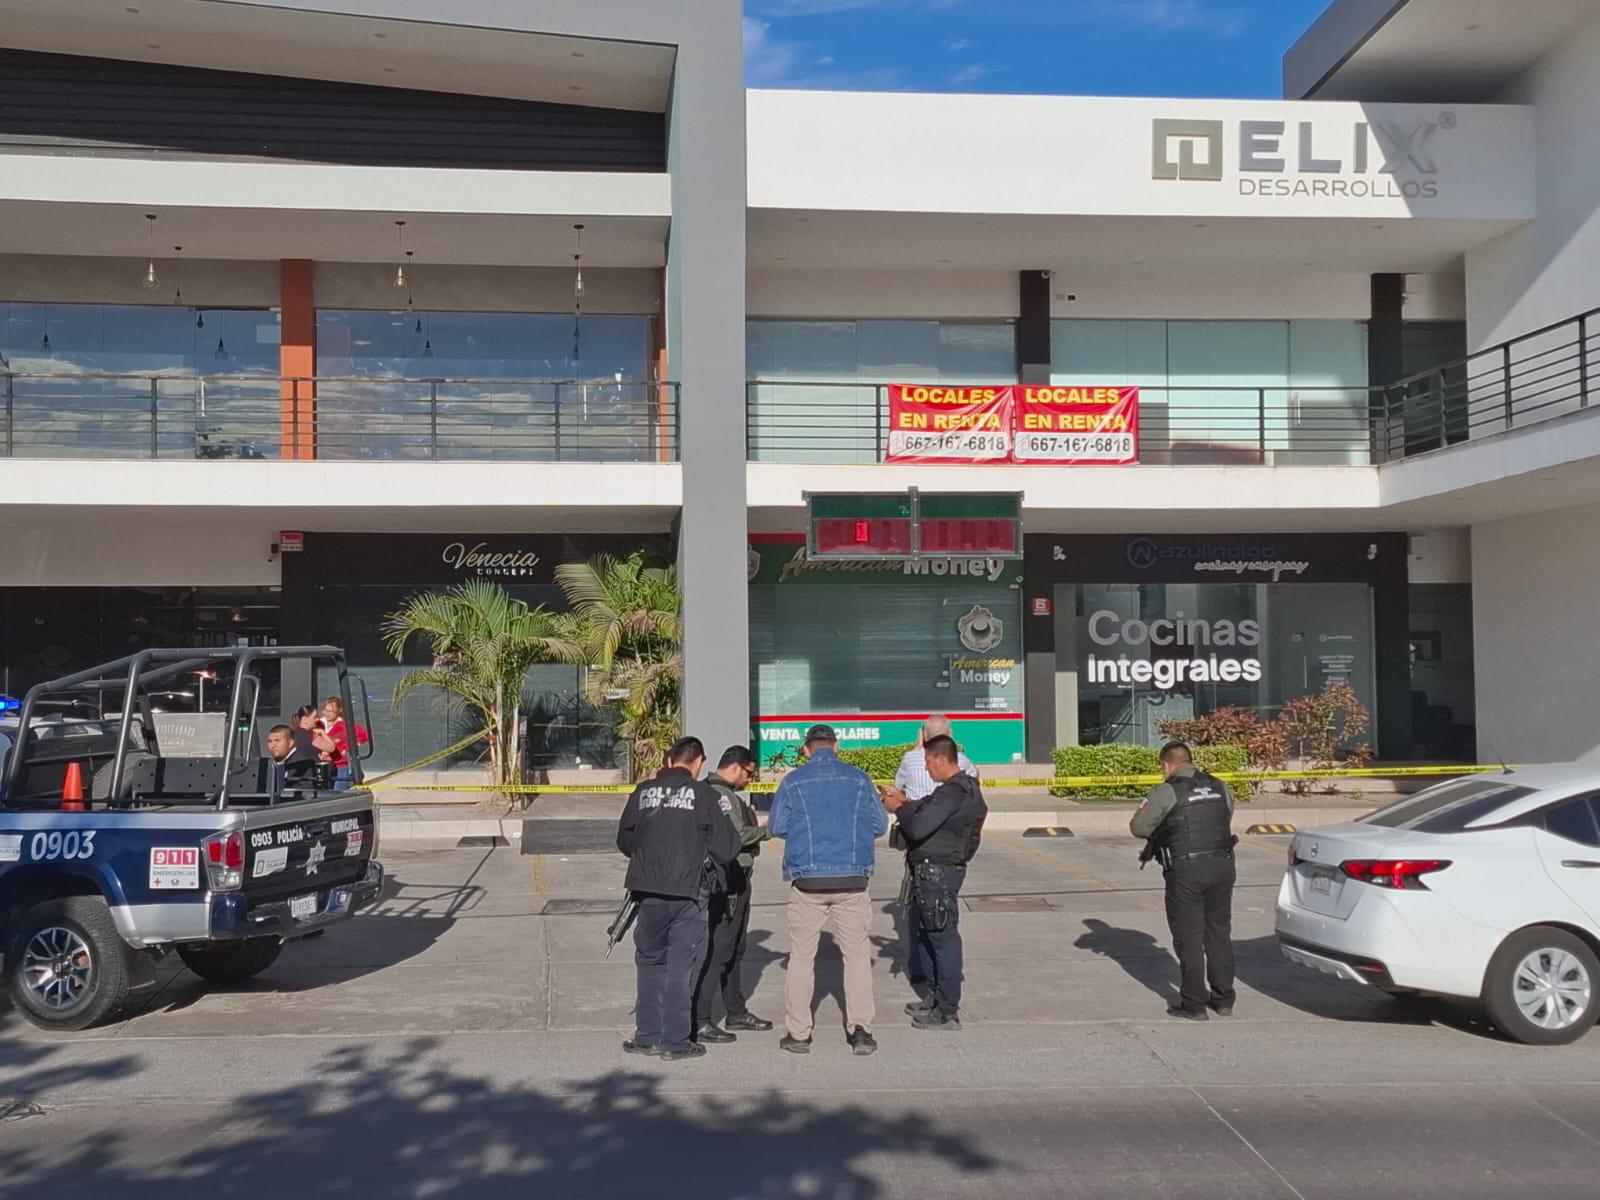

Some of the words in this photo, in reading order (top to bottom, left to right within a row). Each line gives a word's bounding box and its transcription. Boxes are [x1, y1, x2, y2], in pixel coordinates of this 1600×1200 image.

[1239, 179, 1438, 199] DESARROLLOS
[901, 388, 996, 405] LOCALES
[1025, 388, 1120, 404] LOCALES
[900, 413, 927, 429] EN
[934, 413, 1001, 430] RENTA
[1024, 414, 1052, 430] EN
[1059, 414, 1127, 430] RENTA
[904, 436, 1005, 452] 667-167-6818
[1031, 437, 1131, 453] 667-167-6818
[442, 542, 540, 570] Venecia
[477, 568, 534, 576] CONCEPT
[903, 558, 1005, 582] Money
[1088, 610, 1262, 646] Cocinas
[952, 655, 1016, 669] American
[961, 669, 1011, 686] Money
[1088, 653, 1262, 689] Integrales
[761, 728, 801, 741] VENTA
[834, 727, 880, 740] OLARES
[639, 785, 696, 802] POLIÍA
[639, 798, 695, 810] MUNIPAL
[251, 832, 273, 848] 0903
[277, 825, 304, 845] POLICÍA
[331, 817, 360, 835] MUNICIPAL
[31, 830, 97, 861] 0903
[155, 851, 194, 864] 911
